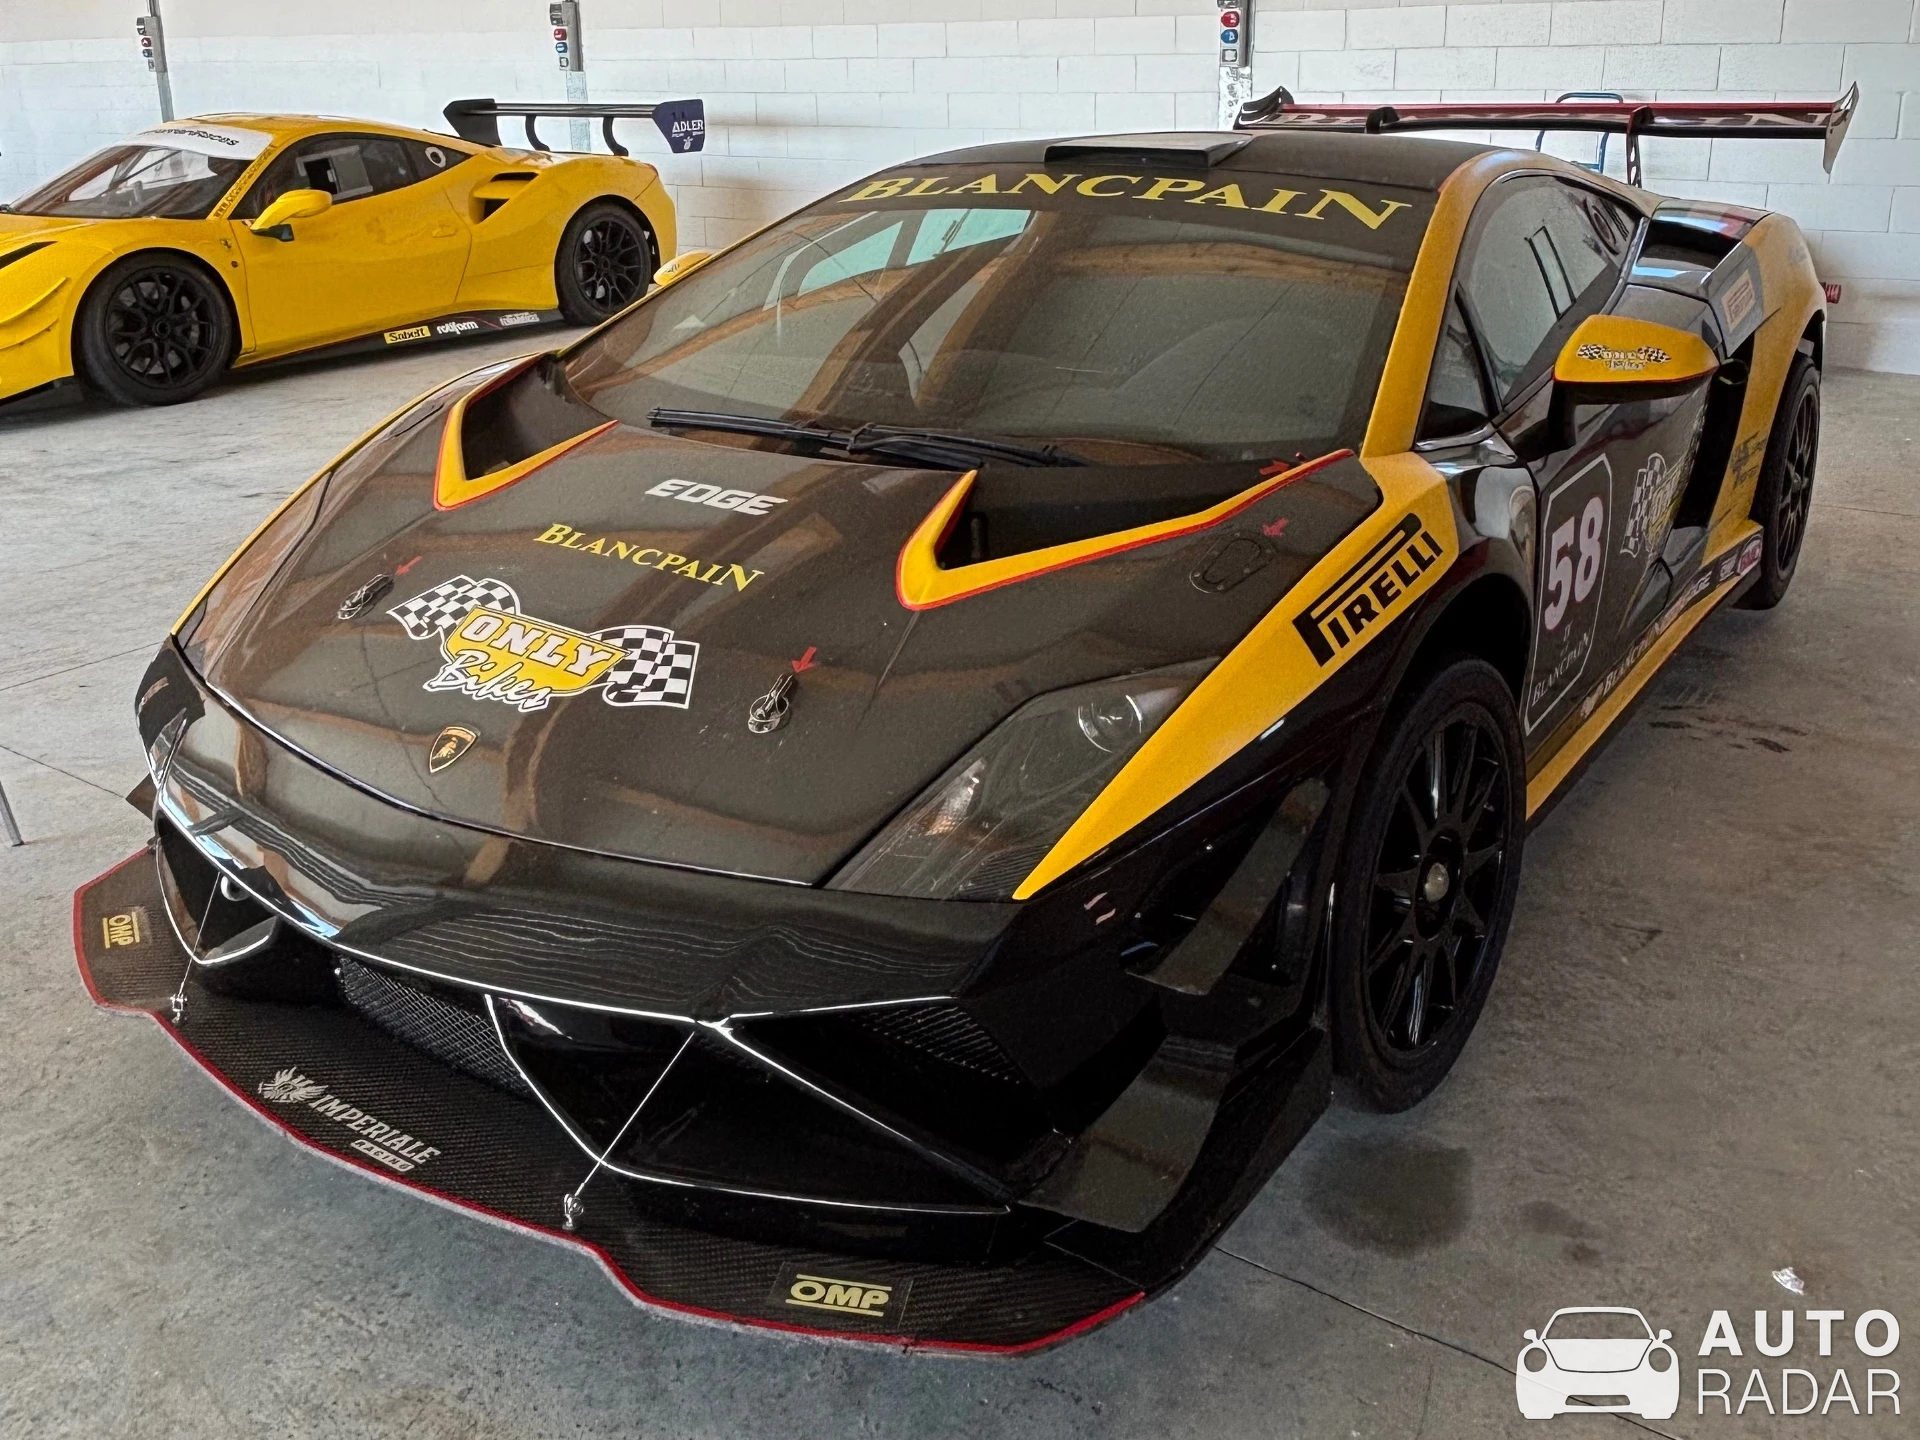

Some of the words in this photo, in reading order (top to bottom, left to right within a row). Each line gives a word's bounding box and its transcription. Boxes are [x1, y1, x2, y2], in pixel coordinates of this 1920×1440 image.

[672, 119, 704, 133] ADLER
[836, 173, 1413, 230] BLANCPAIN
[437, 320, 479, 335] rotiform
[644, 478, 789, 516] EDGE
[533, 523, 765, 592] BLANCPAIN
[1544, 496, 1604, 630] 58
[1291, 512, 1444, 668] PIRELLI
[460, 614, 616, 677] ONLY
[424, 649, 552, 711] Bikes
[107, 913, 135, 947] OMP
[308, 1094, 442, 1165] IMPERIALE
[352, 1139, 414, 1172] RACING
[790, 1279, 890, 1310] OMP
